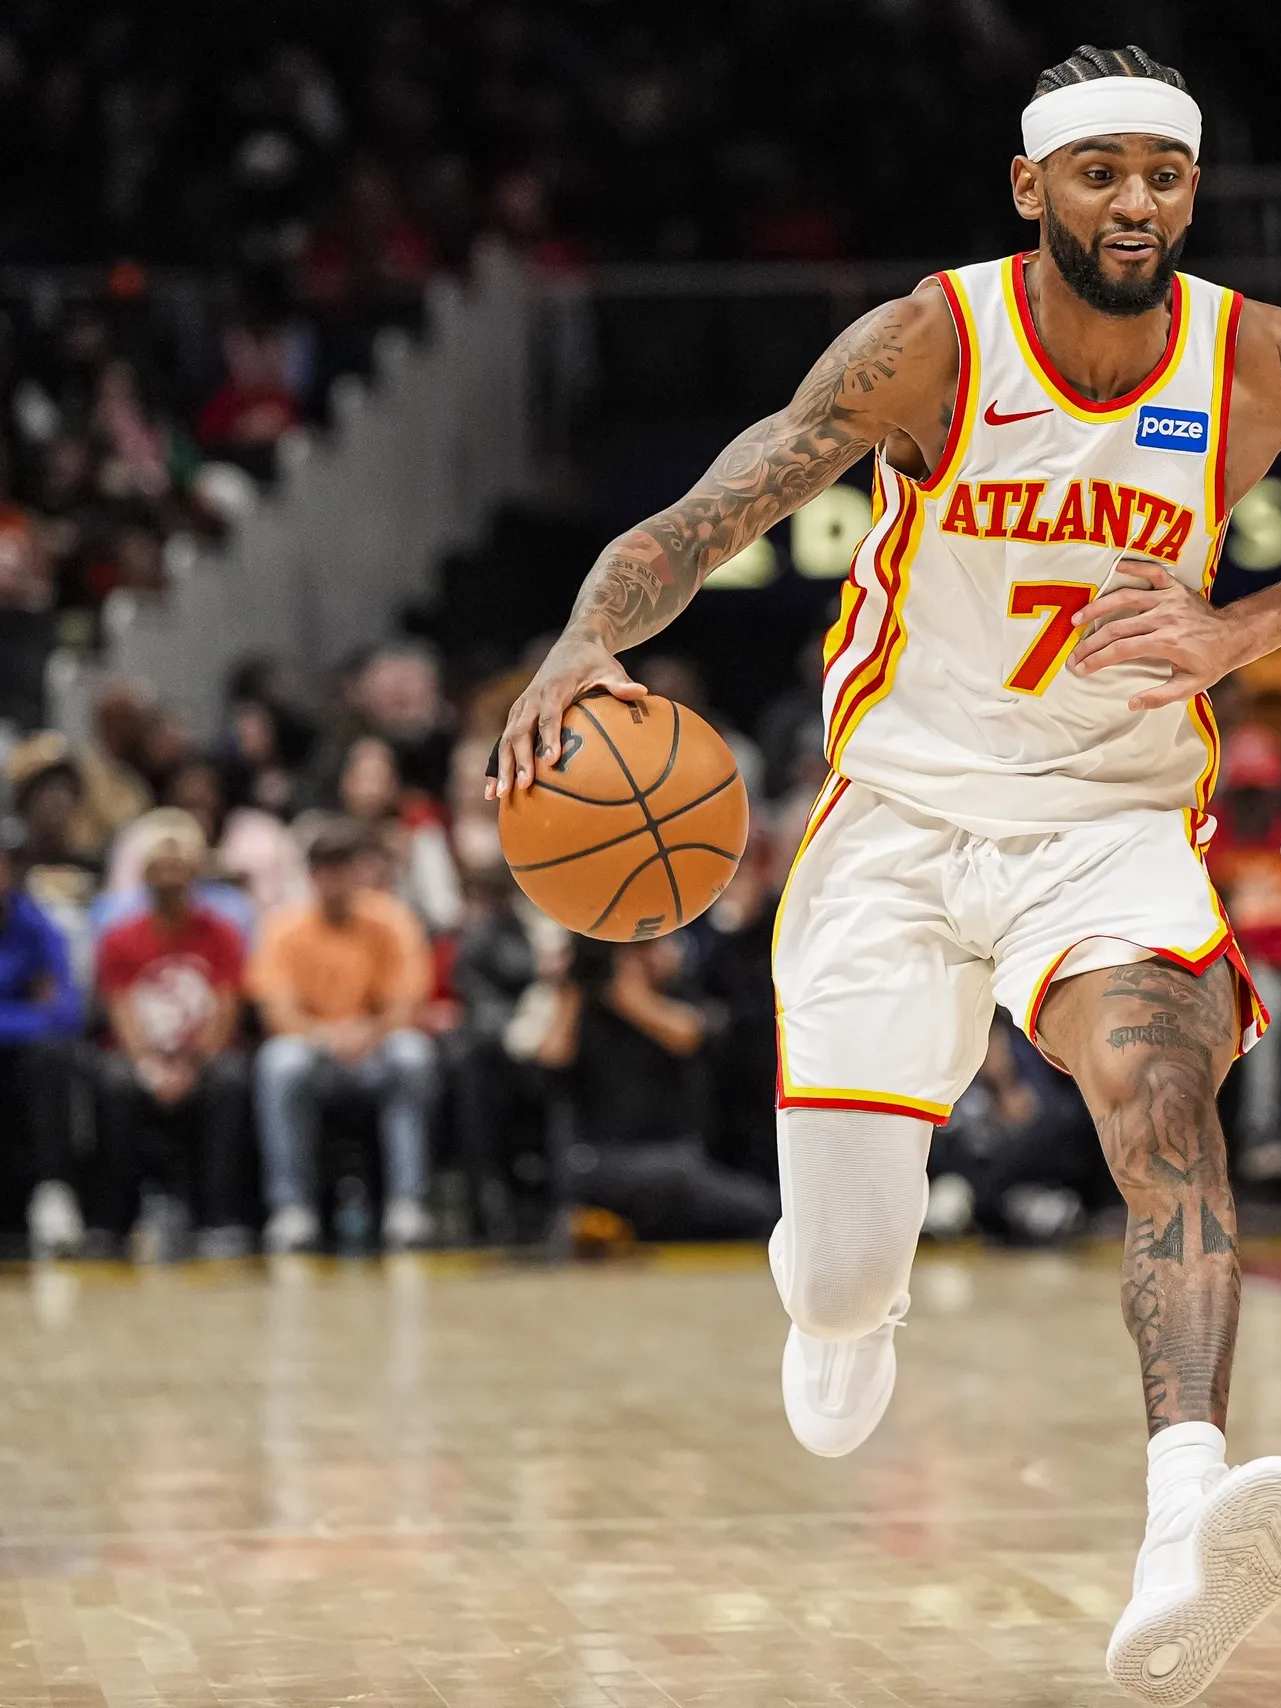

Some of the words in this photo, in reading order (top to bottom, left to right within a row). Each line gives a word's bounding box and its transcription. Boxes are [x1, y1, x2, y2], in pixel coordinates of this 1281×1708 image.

[1141, 416, 1204, 439] paze
[940, 478, 1196, 565] ATLANTA
[1003, 580, 1100, 698] 7
